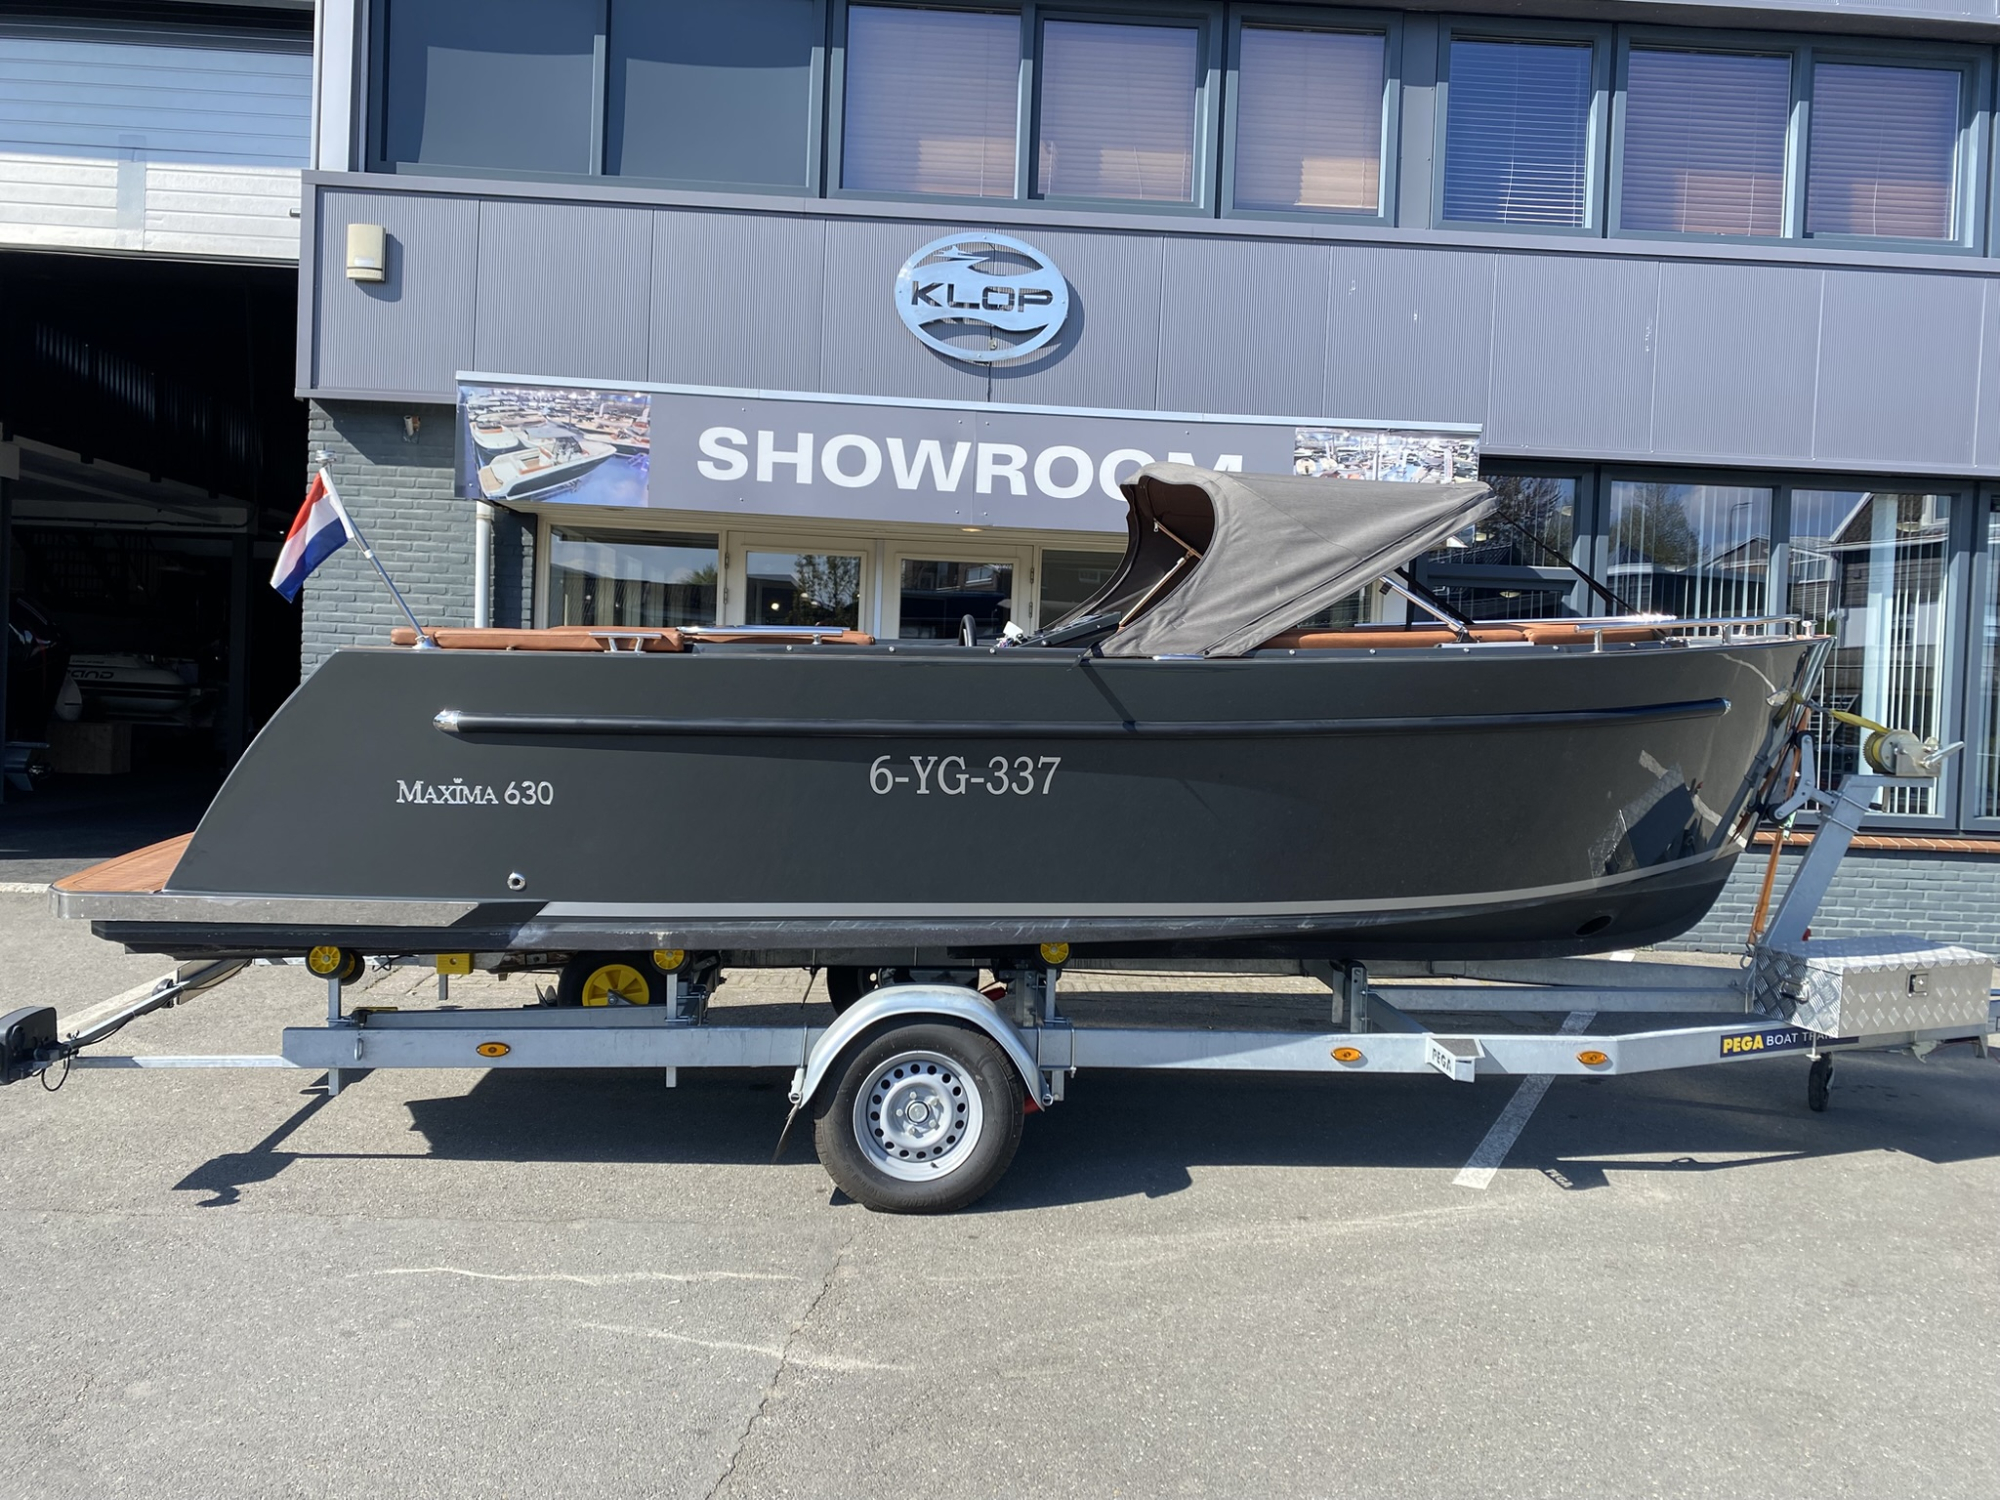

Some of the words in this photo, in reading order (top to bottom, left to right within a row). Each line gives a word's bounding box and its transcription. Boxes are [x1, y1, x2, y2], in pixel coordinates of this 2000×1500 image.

[911, 280, 1054, 313] KLOP
[869, 755, 1062, 795] 6-YG-337
[504, 781, 554, 805] 630
[1722, 1034, 1764, 1053] PEGA
[1766, 1032, 1798, 1046] BOAT
[1432, 1048, 1452, 1073] PEGA
